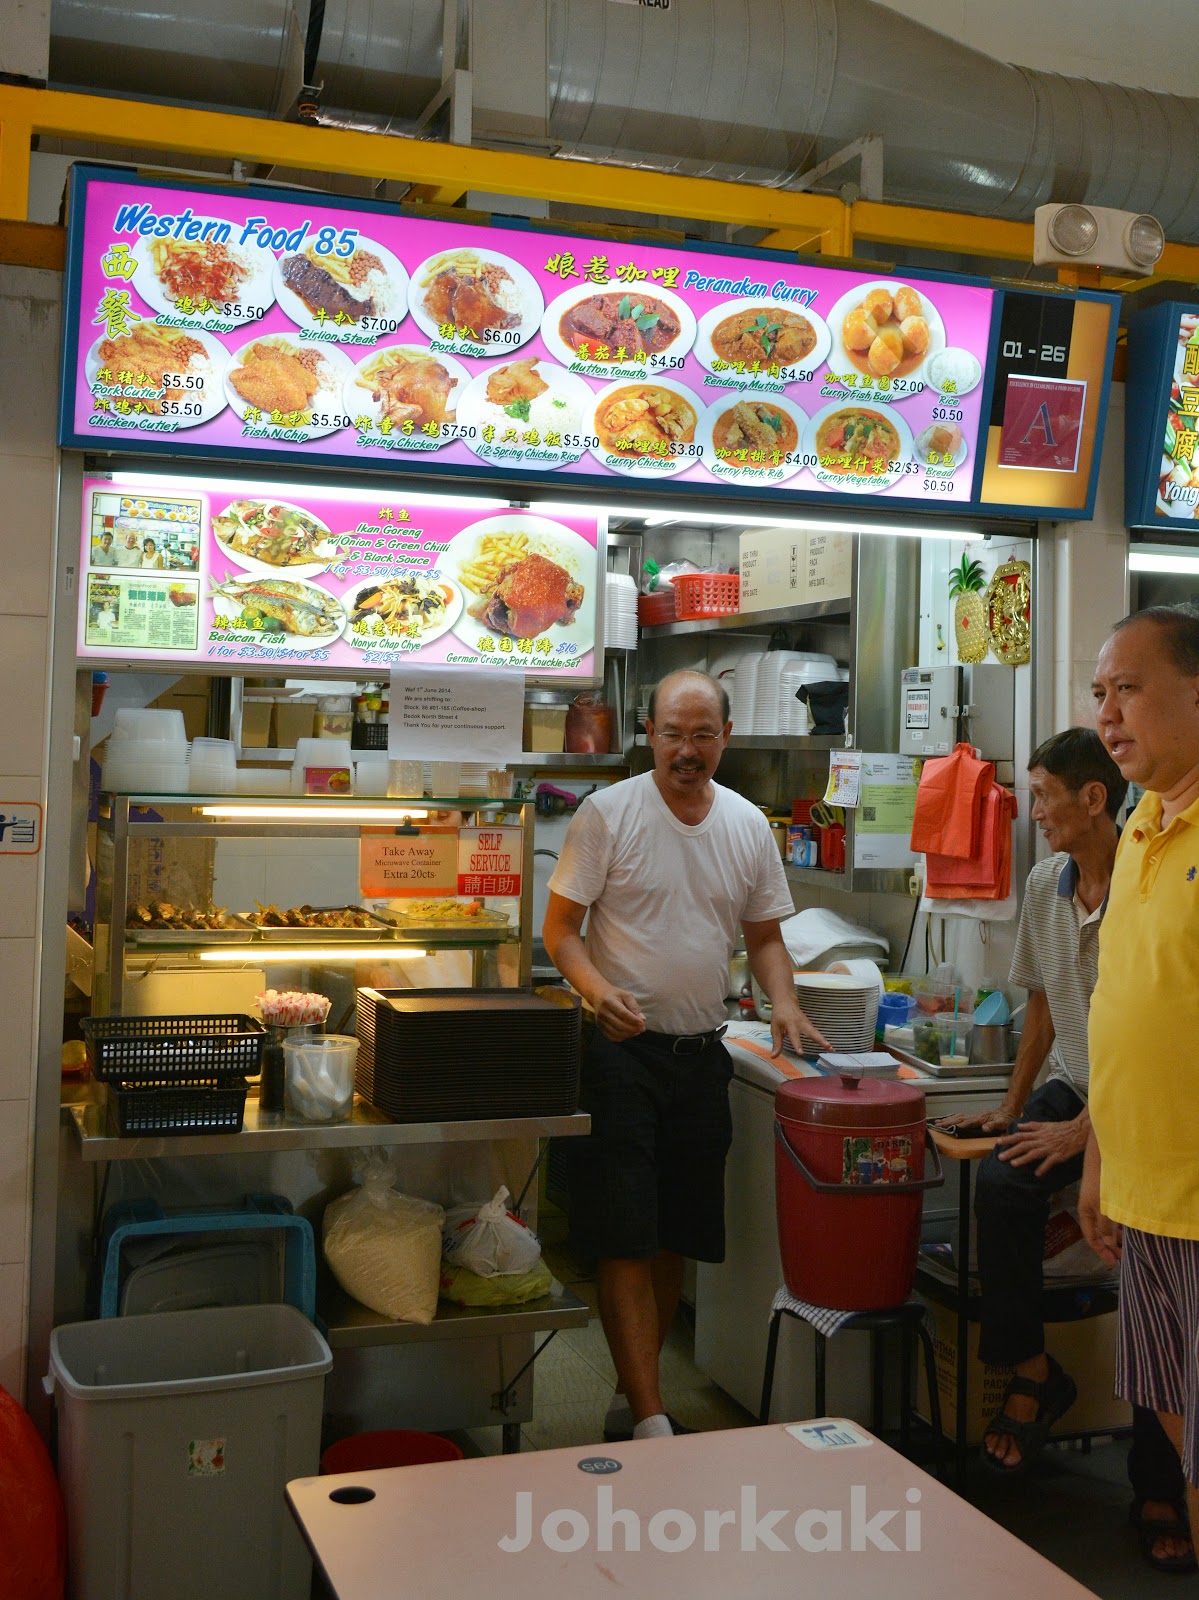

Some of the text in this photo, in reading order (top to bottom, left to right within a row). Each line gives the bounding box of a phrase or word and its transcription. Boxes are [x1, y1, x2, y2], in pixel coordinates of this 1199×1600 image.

[114, 204, 358, 257] Western Food 85
[94, 244, 142, 338] 西餐
[684, 271, 818, 308] Peranakan Curry
[174, 296, 221, 314] 鸡扒
[224, 303, 264, 320] $5.50
[156, 314, 234, 333] Chicken Chop
[312, 308, 357, 326] 牛扒
[361, 317, 397, 331] $7.00
[299, 329, 377, 345] Sirlion Steak
[439, 324, 479, 340] 猪扒
[484, 329, 521, 344] $6.00
[430, 341, 485, 356] Pork Chop
[650, 353, 685, 369] $4.50
[569, 362, 647, 379] Mutton Tomato
[781, 366, 814, 382] $4.50
[163, 374, 204, 390] $5.50
[704, 376, 784, 392] Rendang Mutton
[893, 379, 924, 392] $2.00
[91, 383, 165, 399] Pork Cutlet
[820, 387, 891, 401] Curry Fish Ball
[161, 400, 202, 416] $5.50
[939, 396, 959, 405] Rice
[311, 413, 350, 428] $5.50
[932, 408, 963, 421] $0.50
[89, 414, 179, 432] Chicken Cutlet
[242, 426, 309, 442] Fish N Chip
[442, 425, 476, 439] $7.50
[356, 436, 440, 450] Spring Chicken
[564, 434, 600, 449] $5.50
[493, 447, 522, 459] Spring
[525, 449, 559, 461] Chicken
[561, 451, 580, 462] Rice
[669, 442, 703, 457] $3.80
[606, 455, 676, 469] Curry Chicken
[785, 451, 817, 466] $4.00
[712, 464, 784, 478] Curry Pork Rib
[888, 462, 919, 474] $2/$3
[926, 468, 954, 477] Bread
[817, 472, 890, 486] Curry Vegetable
[923, 480, 954, 492] $0.50
[356, 524, 422, 539] Ikan Goreng
[375, 539, 385, 548] &
[388, 540, 420, 551] Green
[423, 542, 450, 553] Chilli
[350, 552, 429, 565] & Black Souce
[333, 565, 349, 574] for
[424, 568, 441, 579] $5
[209, 631, 287, 644] Belacan Fish
[351, 638, 422, 651] Nonya Chap Chye
[216, 646, 235, 656] for
[296, 650, 310, 659] or
[311, 649, 330, 660] $5
[556, 642, 577, 653] $16
[362, 651, 400, 662] $2/$3
[446, 654, 581, 668] German Crispy Pork Knuckle Set
[478, 833, 502, 850] SELF
[382, 847, 435, 858] Take Away
[470, 855, 511, 871] SERVICE
[384, 870, 408, 879] Extra
[464, 876, 514, 894] 請自助
